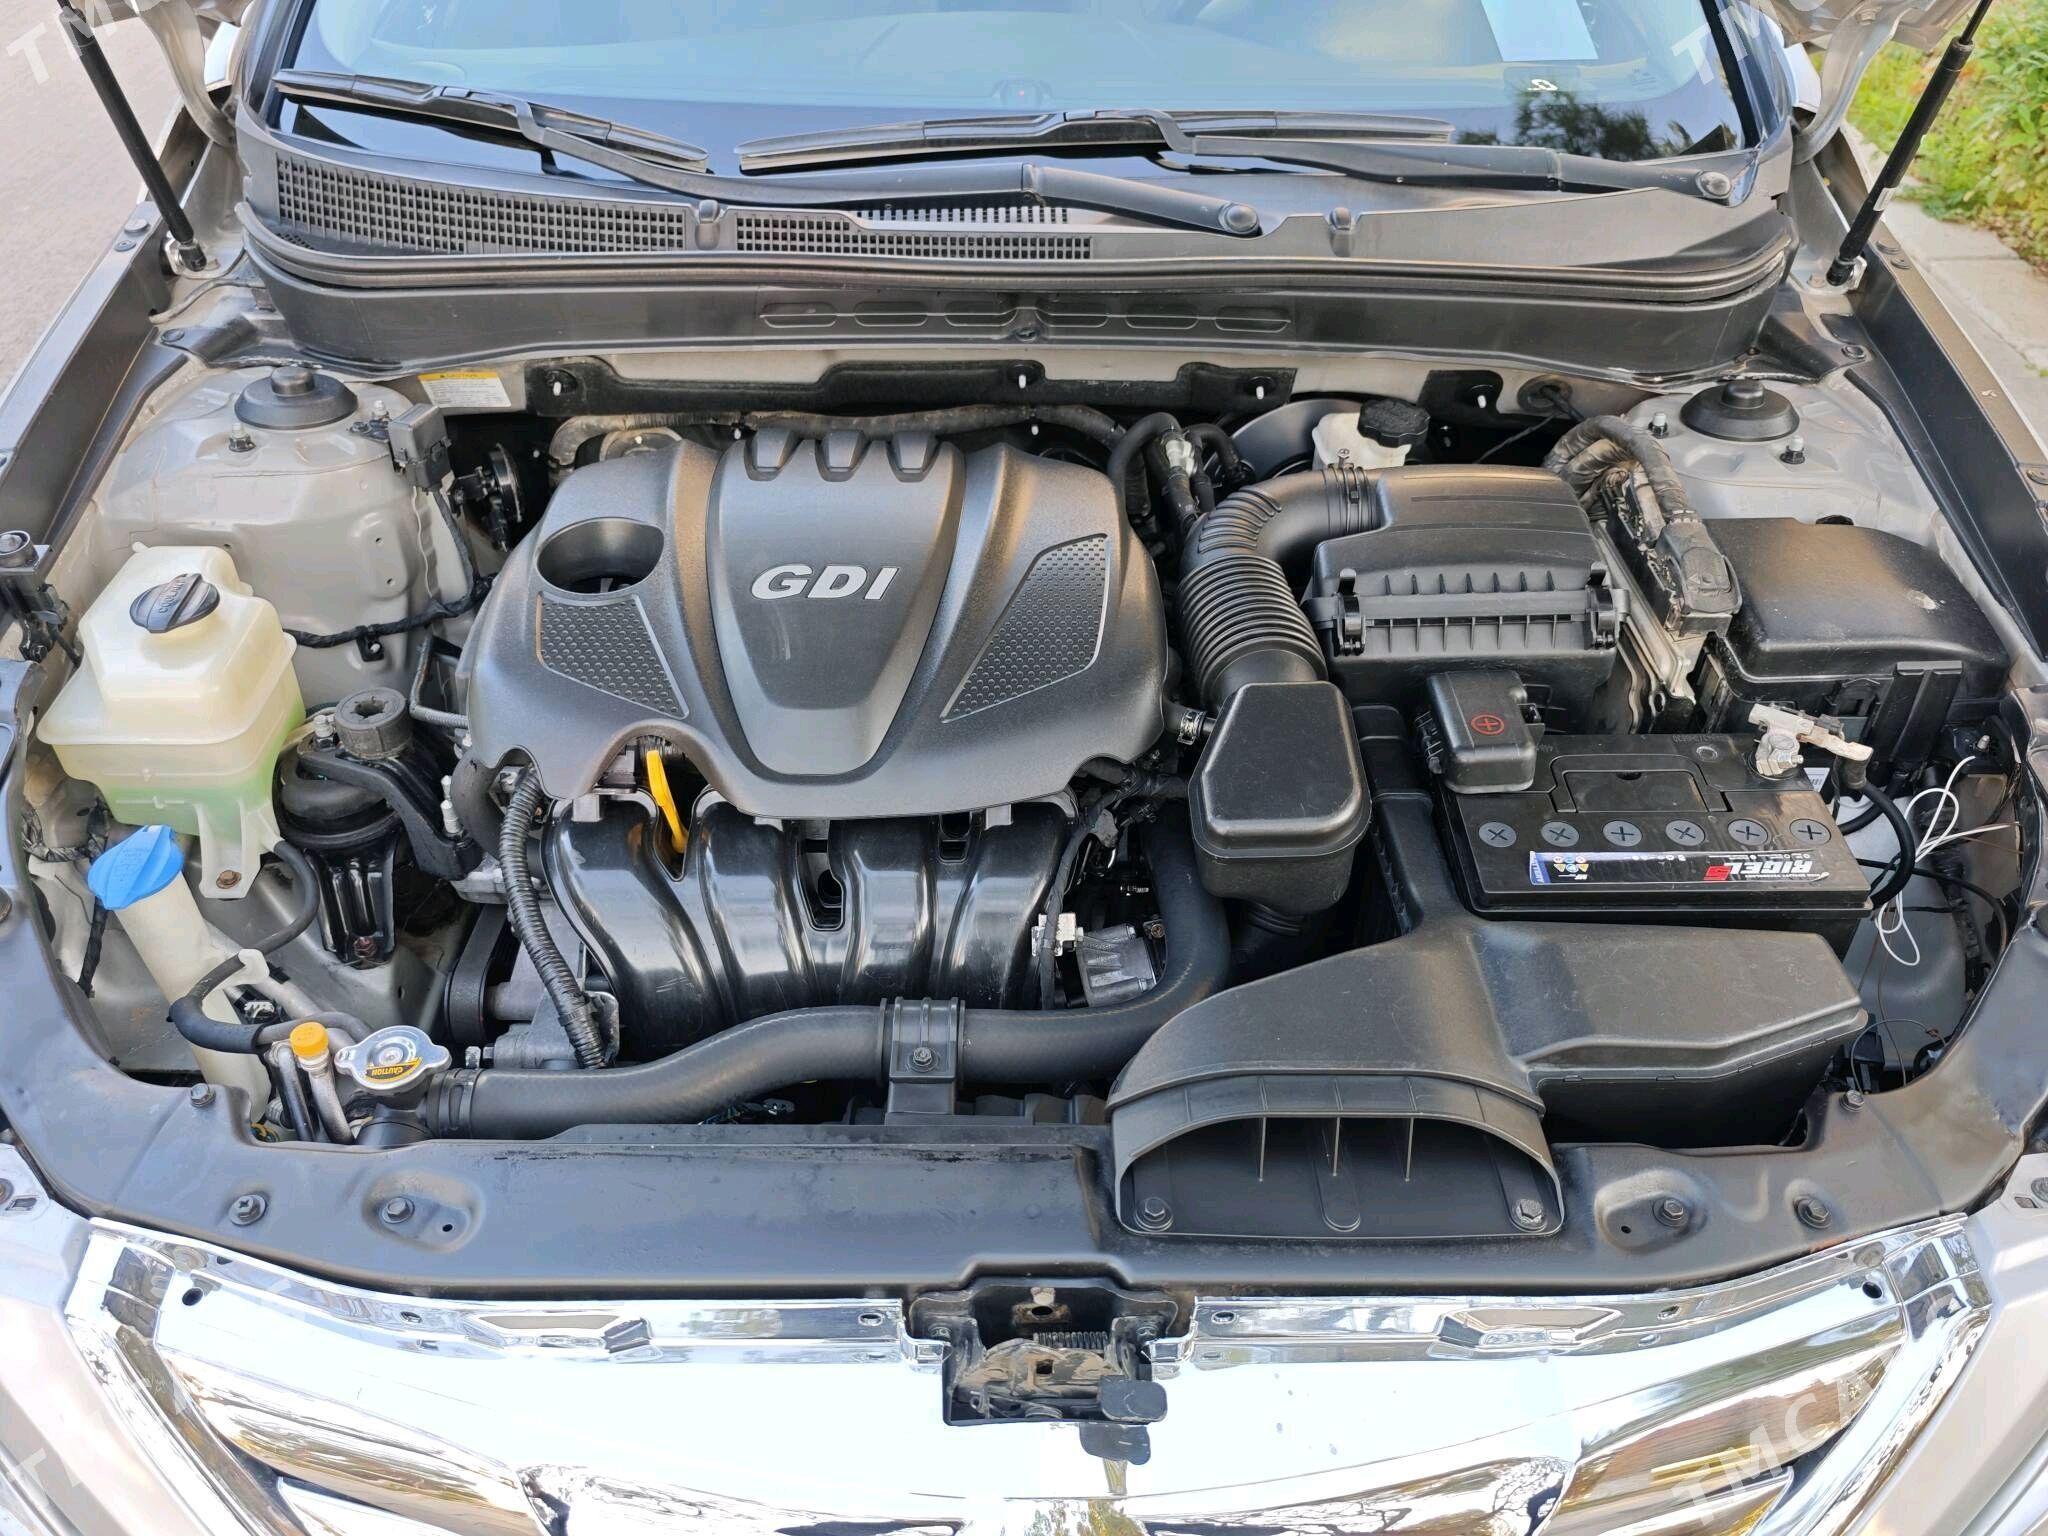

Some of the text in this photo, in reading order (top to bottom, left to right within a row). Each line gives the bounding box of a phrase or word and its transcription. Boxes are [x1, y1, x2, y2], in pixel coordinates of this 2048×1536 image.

[751, 563, 899, 600] GDI
[1724, 860, 1813, 874] RIGEL
[371, 1066, 404, 1076] CAUTION
